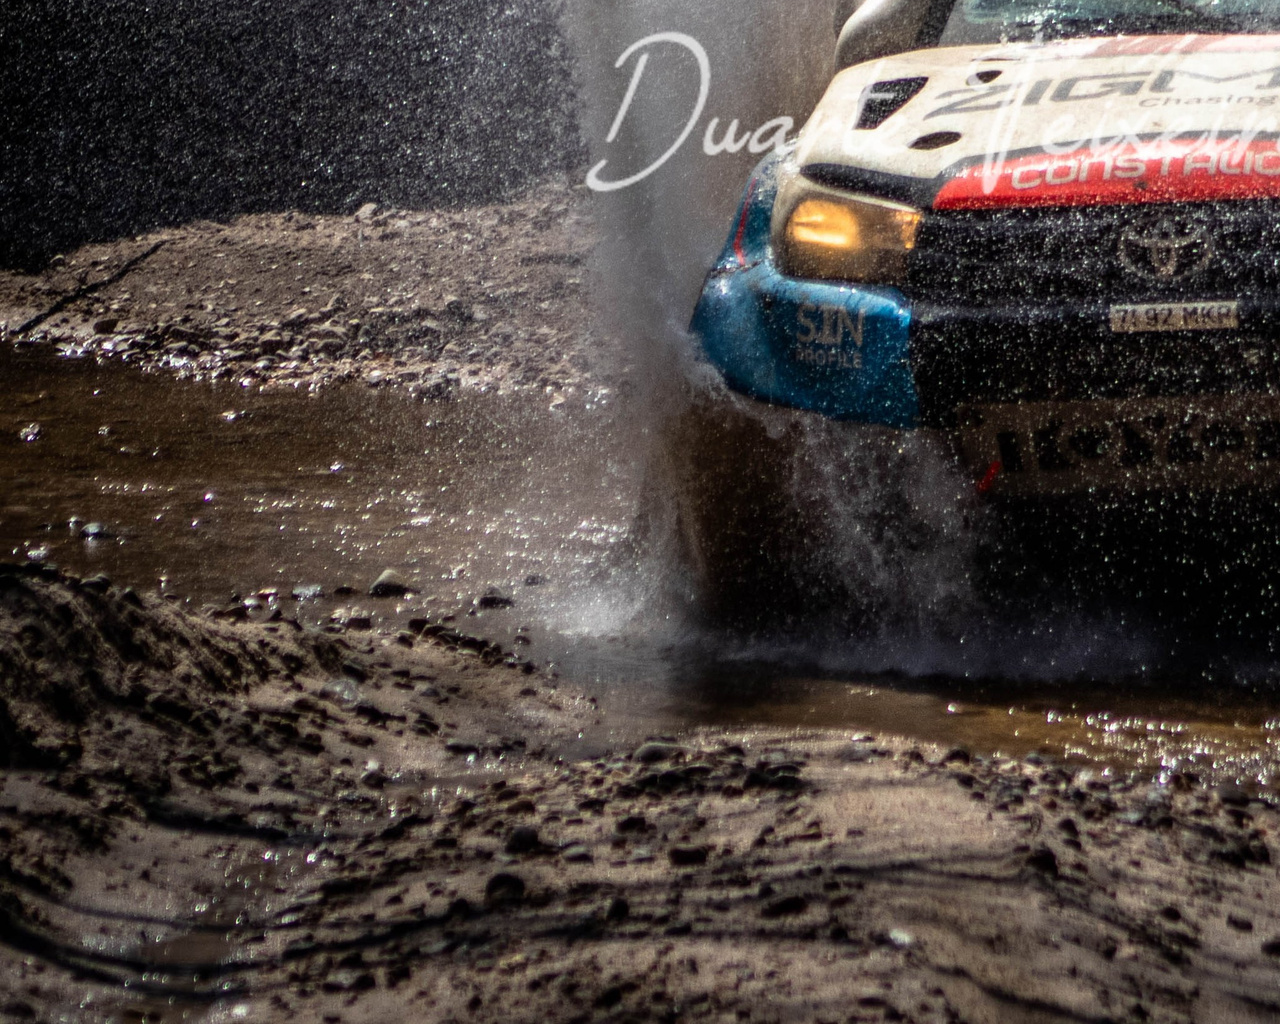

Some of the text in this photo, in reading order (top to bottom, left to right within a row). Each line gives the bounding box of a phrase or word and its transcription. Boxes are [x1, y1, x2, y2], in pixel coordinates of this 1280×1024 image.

[1138, 92, 1278, 110] Chasing
[796, 302, 866, 348] SIN
[795, 348, 863, 371] PROFILE
